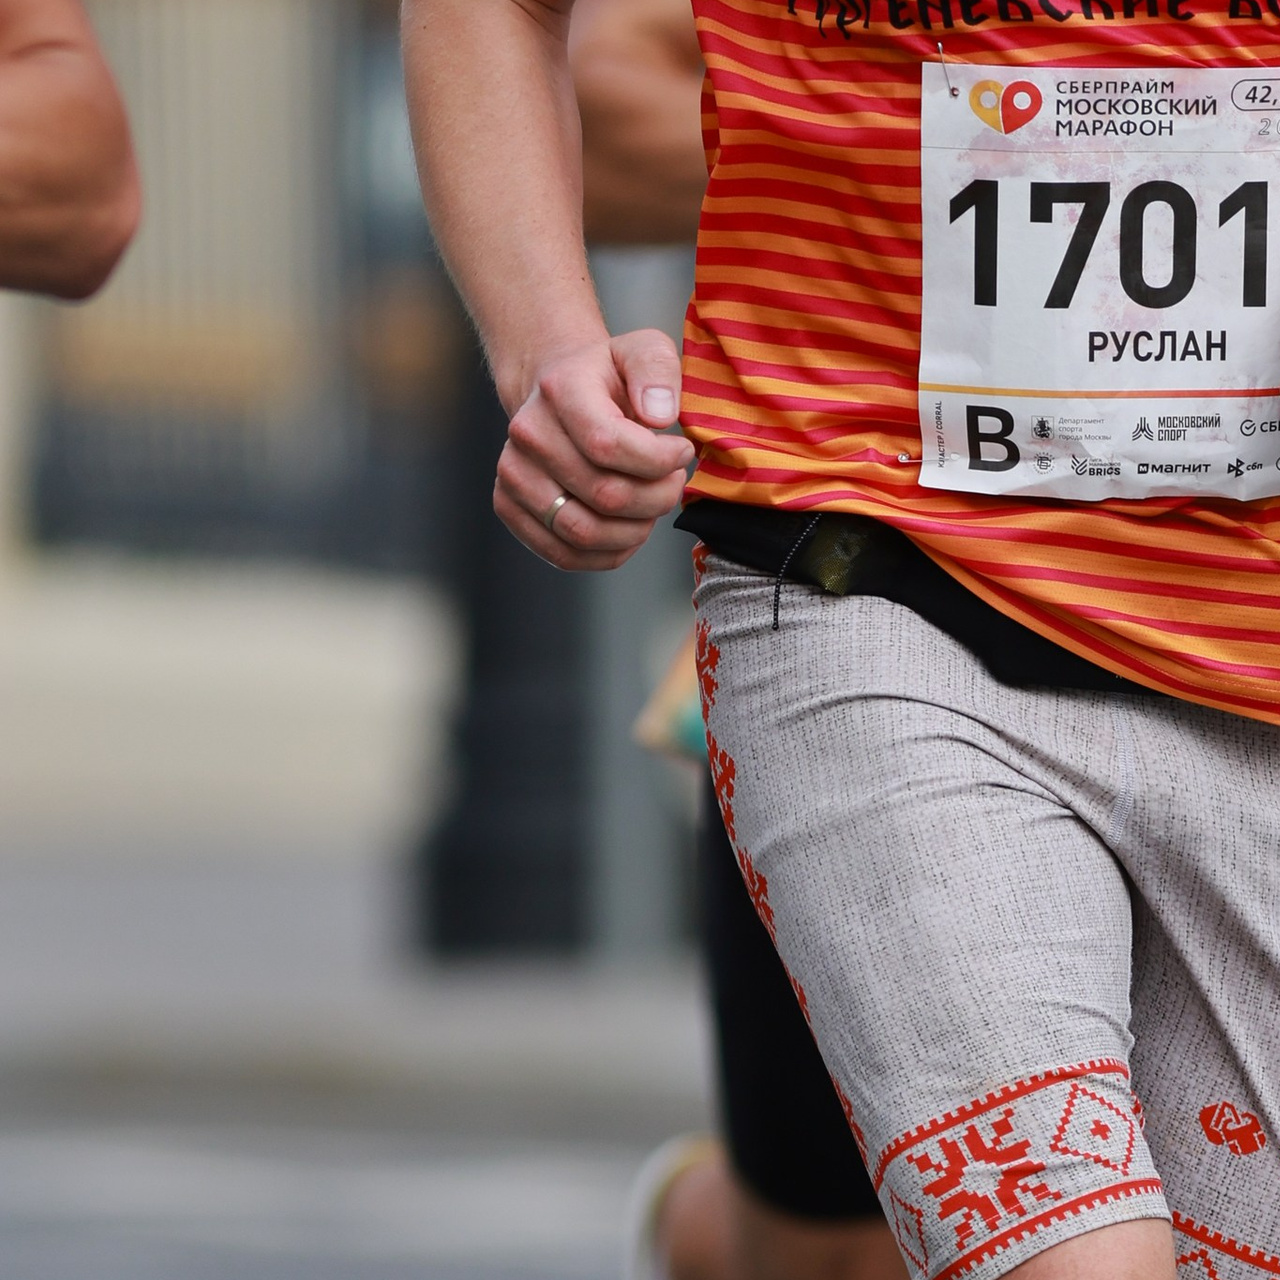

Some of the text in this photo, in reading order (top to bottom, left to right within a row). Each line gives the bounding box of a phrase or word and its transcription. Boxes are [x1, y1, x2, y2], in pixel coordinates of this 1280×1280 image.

[1056, 79, 1174, 94] СБЕРПРАЙМ
[1056, 95, 1217, 116] МОСКОВСКИЙ
[1055, 119, 1173, 137] МАРАФОН
[1088, 329, 1227, 362] РУСЛАН
[935, 400, 943, 430] CORRAL
[1058, 417, 1105, 426] Департамент
[1158, 413, 1221, 429] МОСКОВСКИЙ
[966, 405, 1021, 472] B
[1158, 429, 1187, 442] СПОРТ
[1088, 466, 1121, 476] BRICS
[1246, 461, 1263, 471] сбп
